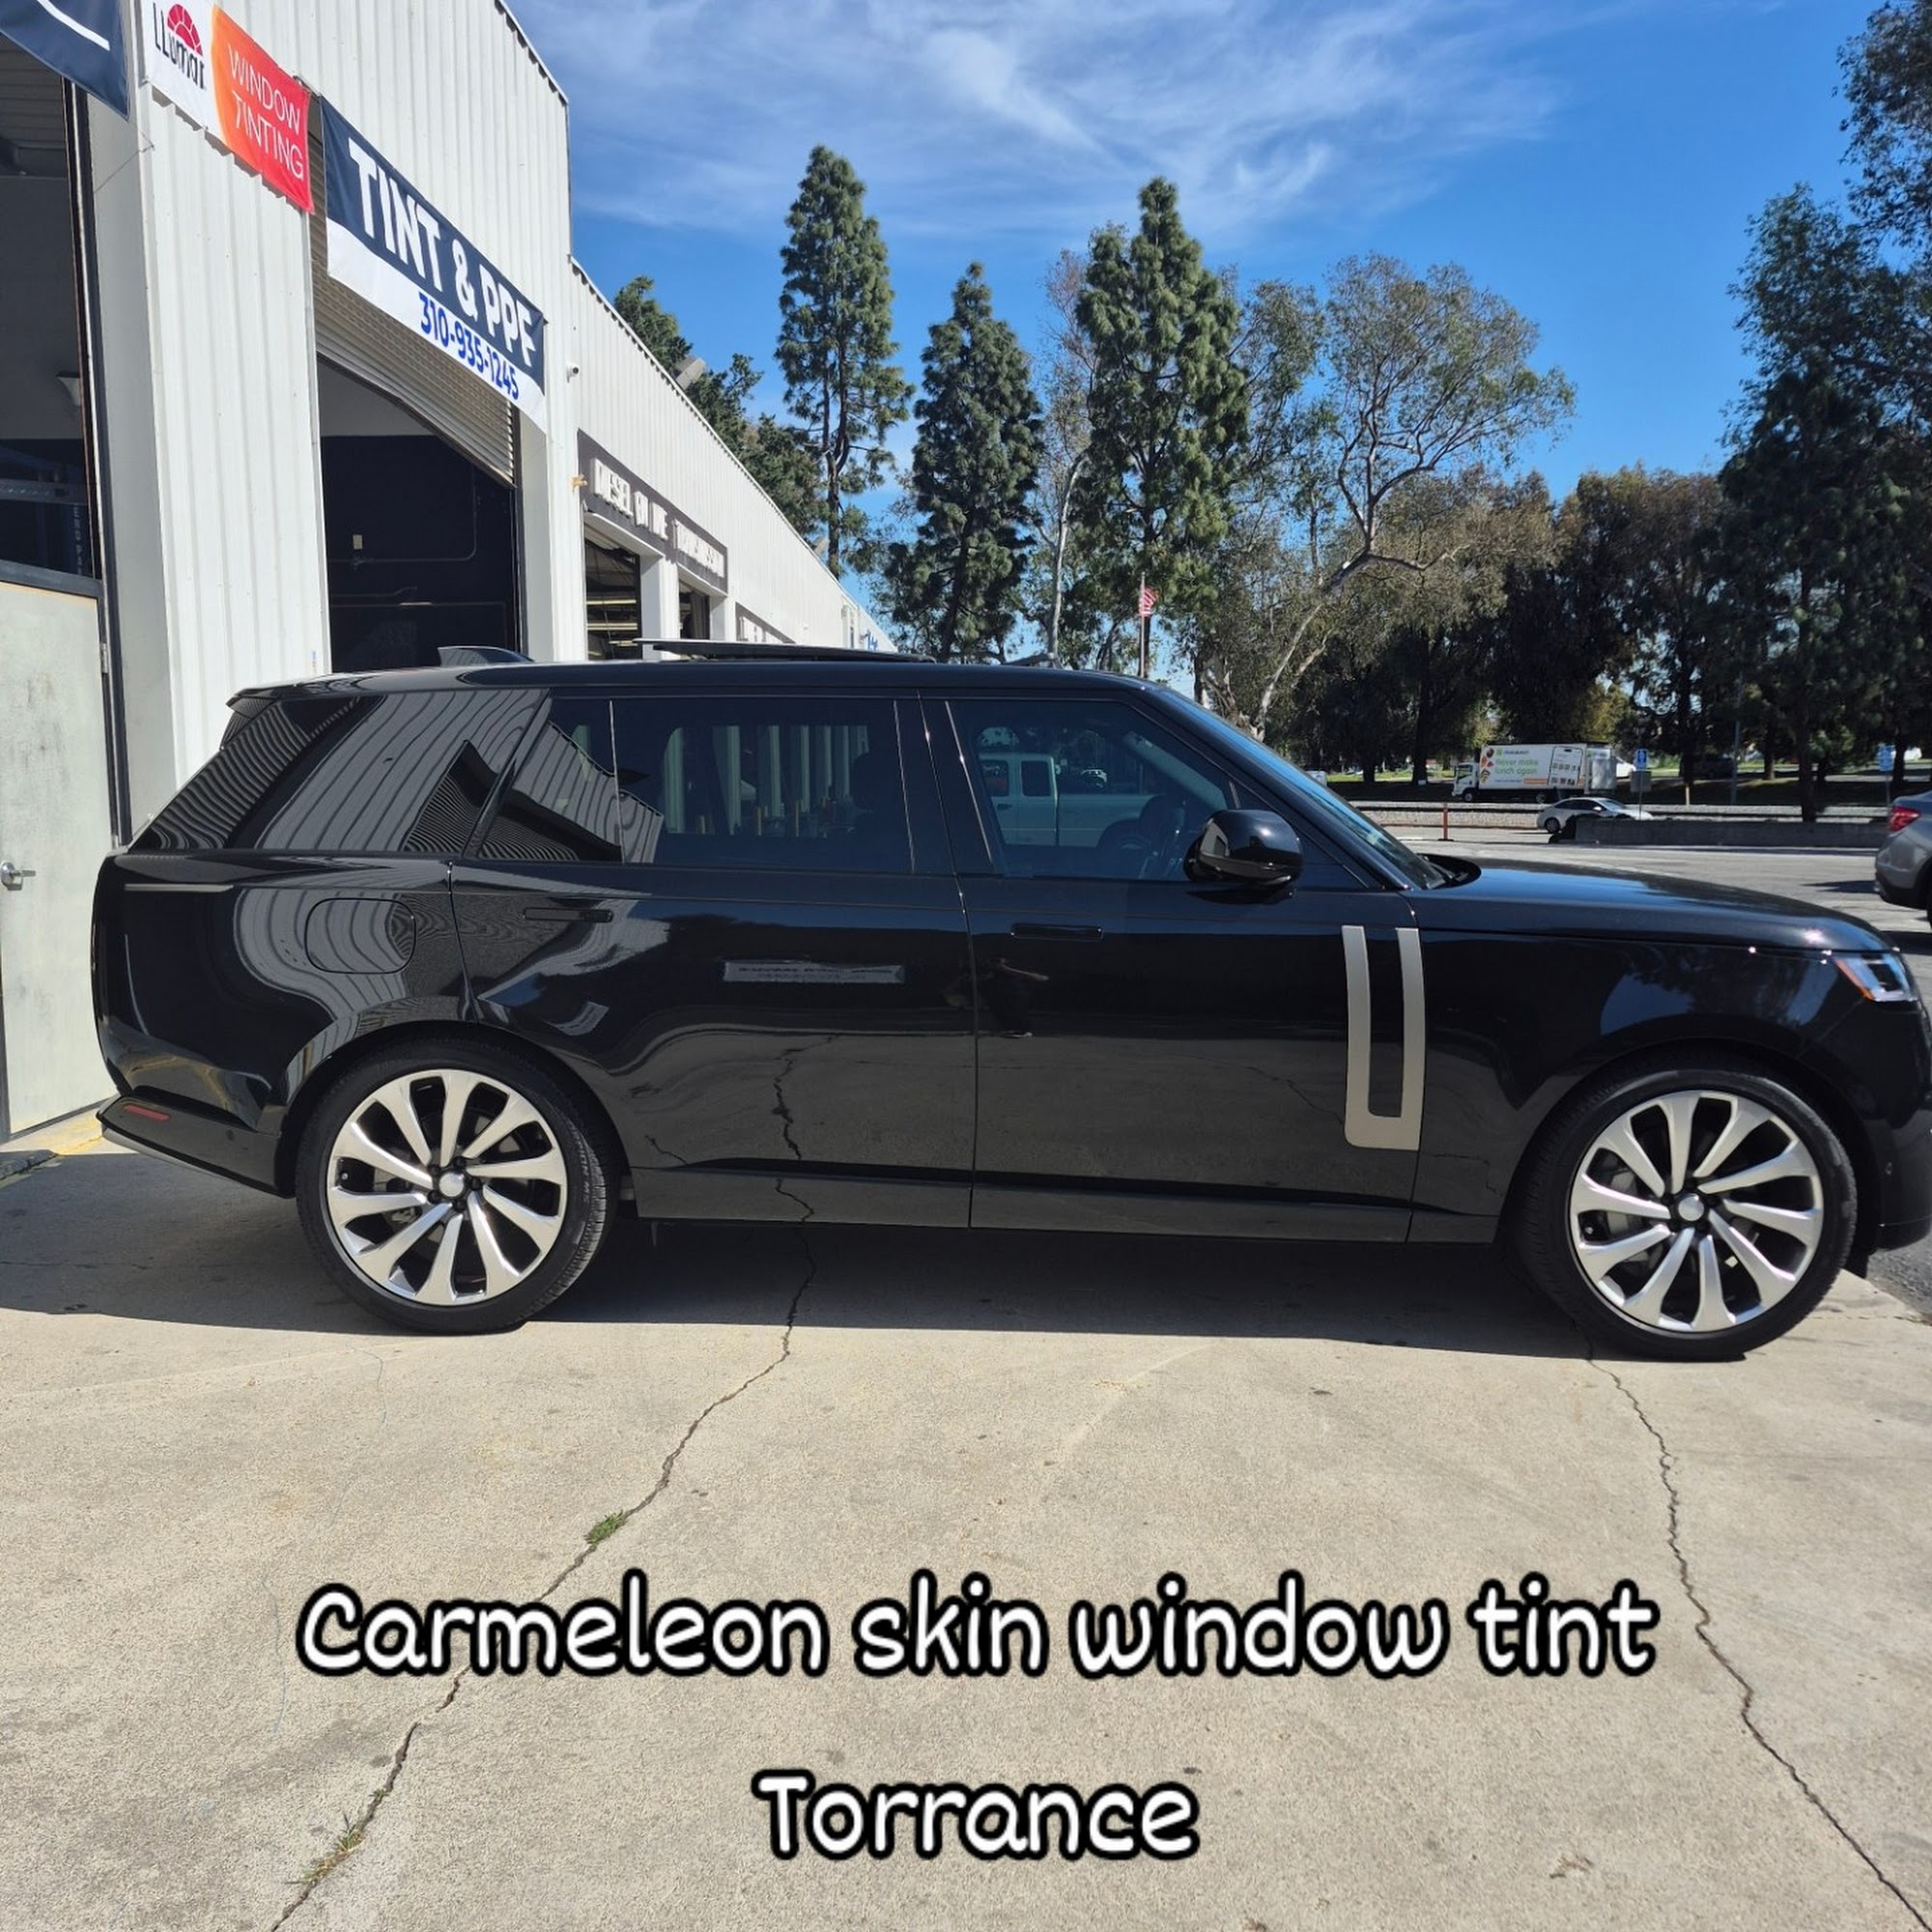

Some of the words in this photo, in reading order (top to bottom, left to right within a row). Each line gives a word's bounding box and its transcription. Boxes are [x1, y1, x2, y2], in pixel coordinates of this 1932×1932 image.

[227, 43, 301, 136] WINDOW
[232, 89, 304, 181] TINTING
[348, 136, 442, 293] TINT
[451, 238, 479, 323] &
[478, 263, 537, 368] PPF
[418, 290, 520, 400] 310-935-1245
